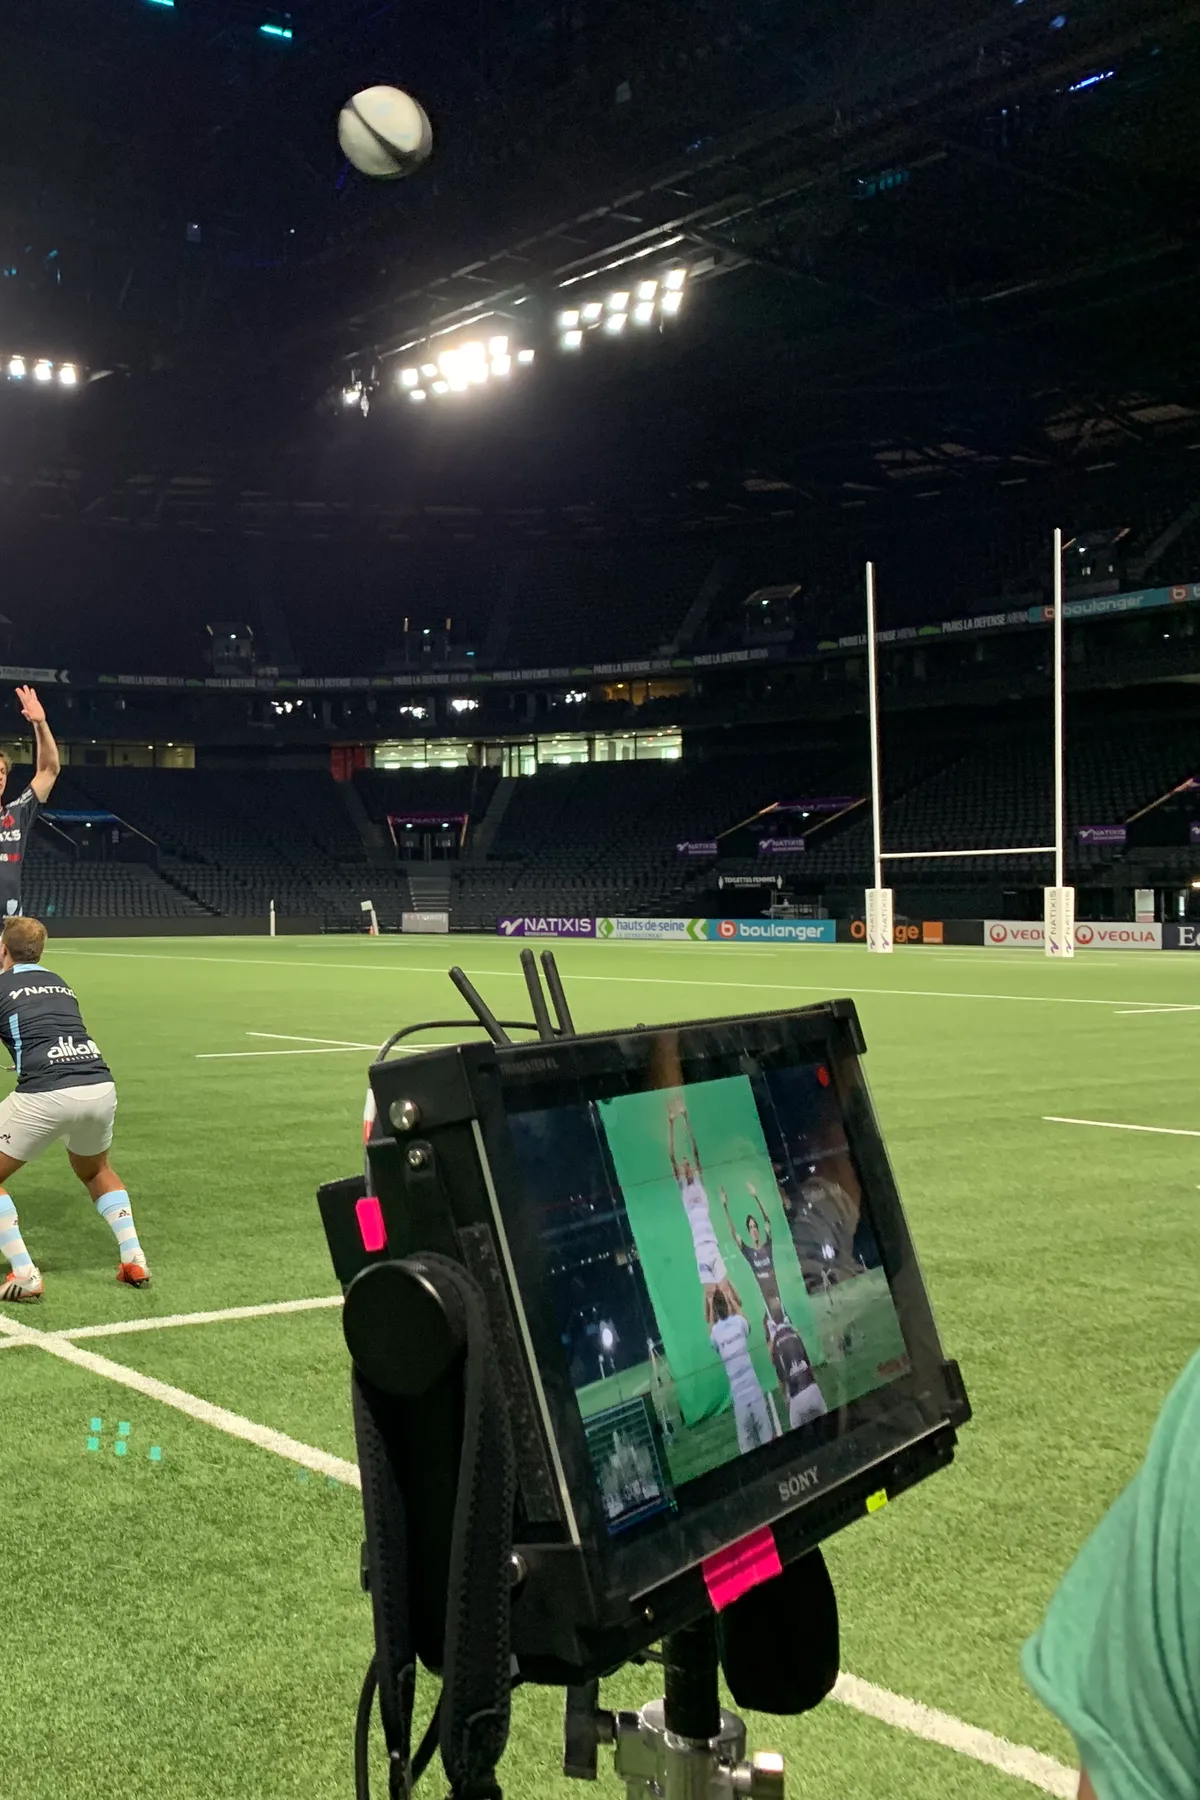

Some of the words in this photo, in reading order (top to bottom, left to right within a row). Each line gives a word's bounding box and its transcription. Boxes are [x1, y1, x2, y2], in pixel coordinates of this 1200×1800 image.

[1063, 595, 1144, 615] boulanger
[1050, 890, 1058, 935] NATIXIS
[524, 918, 592, 932] NATIXIS
[740, 923, 824, 940] boulanger
[1097, 930, 1156, 942] VEOLIA
[778, 1465, 819, 1501] SONY
